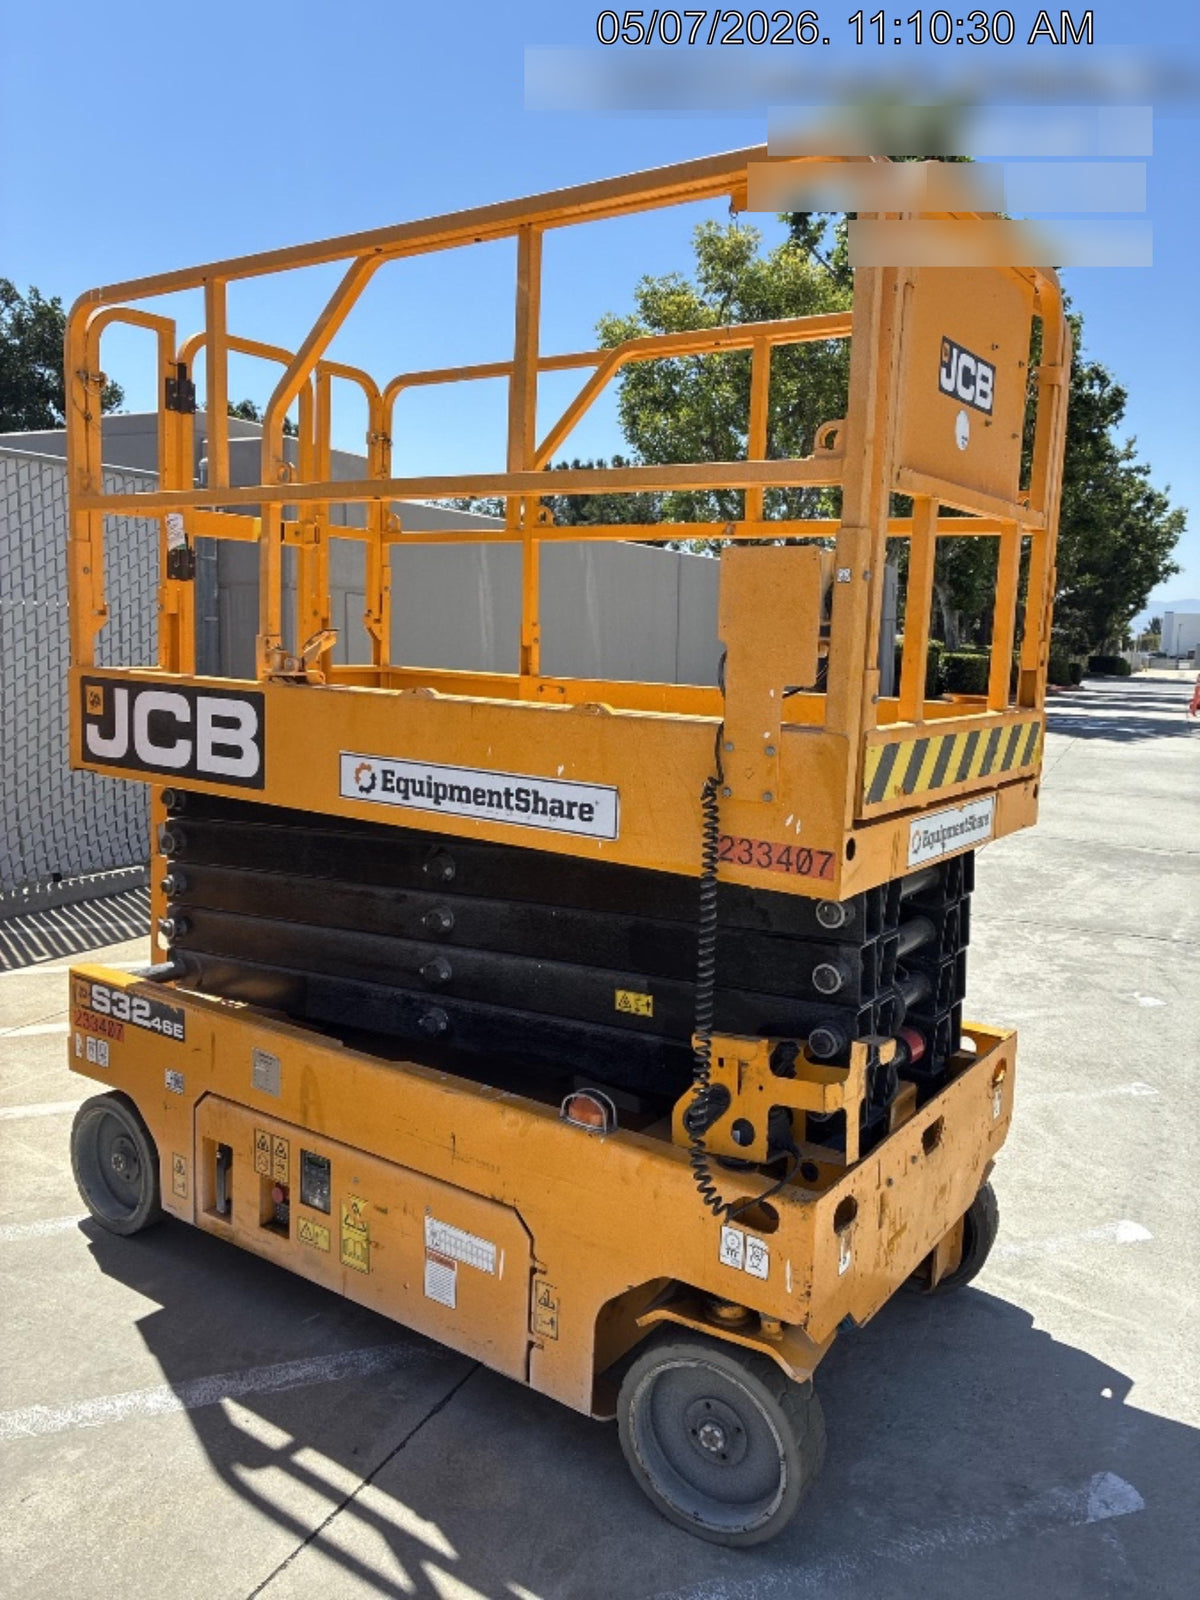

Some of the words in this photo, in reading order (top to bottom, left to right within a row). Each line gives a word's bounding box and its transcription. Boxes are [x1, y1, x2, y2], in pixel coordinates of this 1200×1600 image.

[940, 346, 994, 410] JCB
[86, 687, 260, 778] JCB
[380, 769, 596, 822] EquipmentShare
[718, 834, 835, 877] 233407
